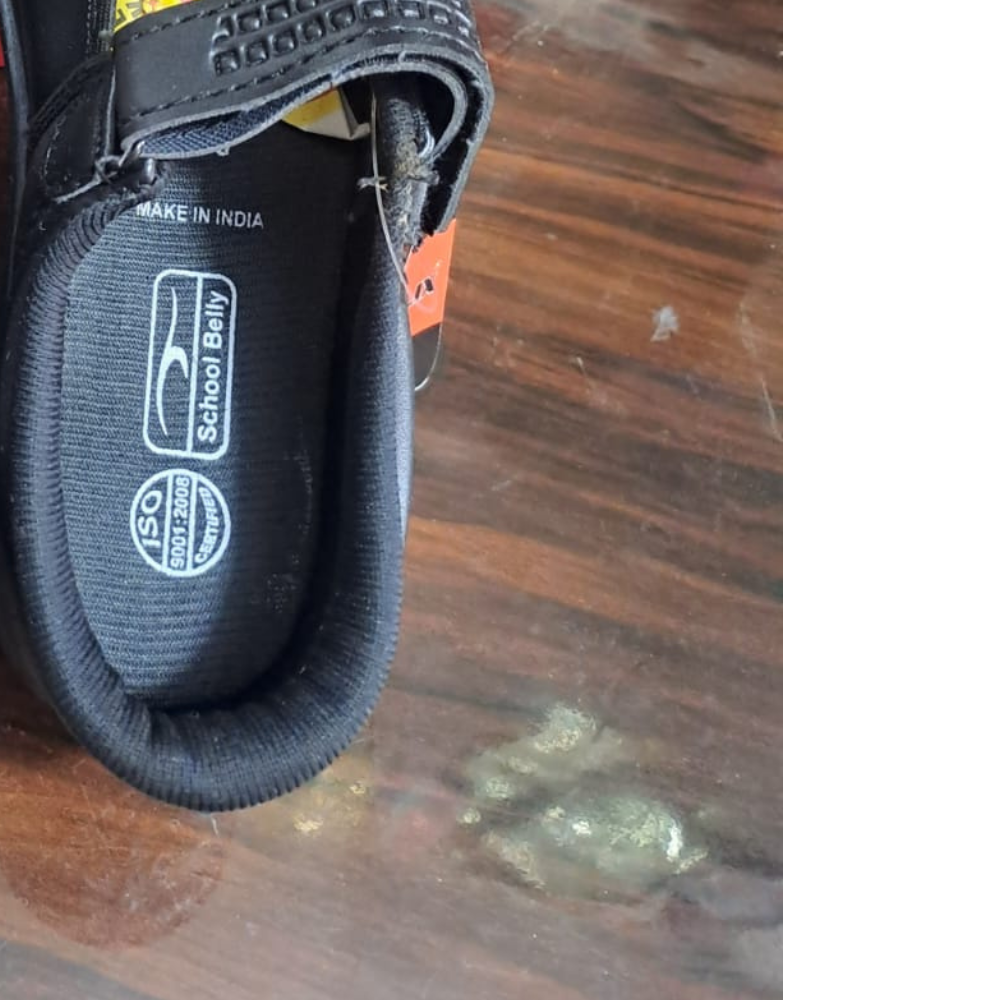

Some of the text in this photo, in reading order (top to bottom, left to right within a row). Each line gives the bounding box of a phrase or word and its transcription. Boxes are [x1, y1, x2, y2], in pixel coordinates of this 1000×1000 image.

[136, 200, 264, 229] MAKE IN INDIA
[197, 290, 230, 443] School Belly
[137, 490, 162, 548] ISO
[170, 477, 191, 568] 9001:2008
[195, 486, 220, 563] CERTIFIED
